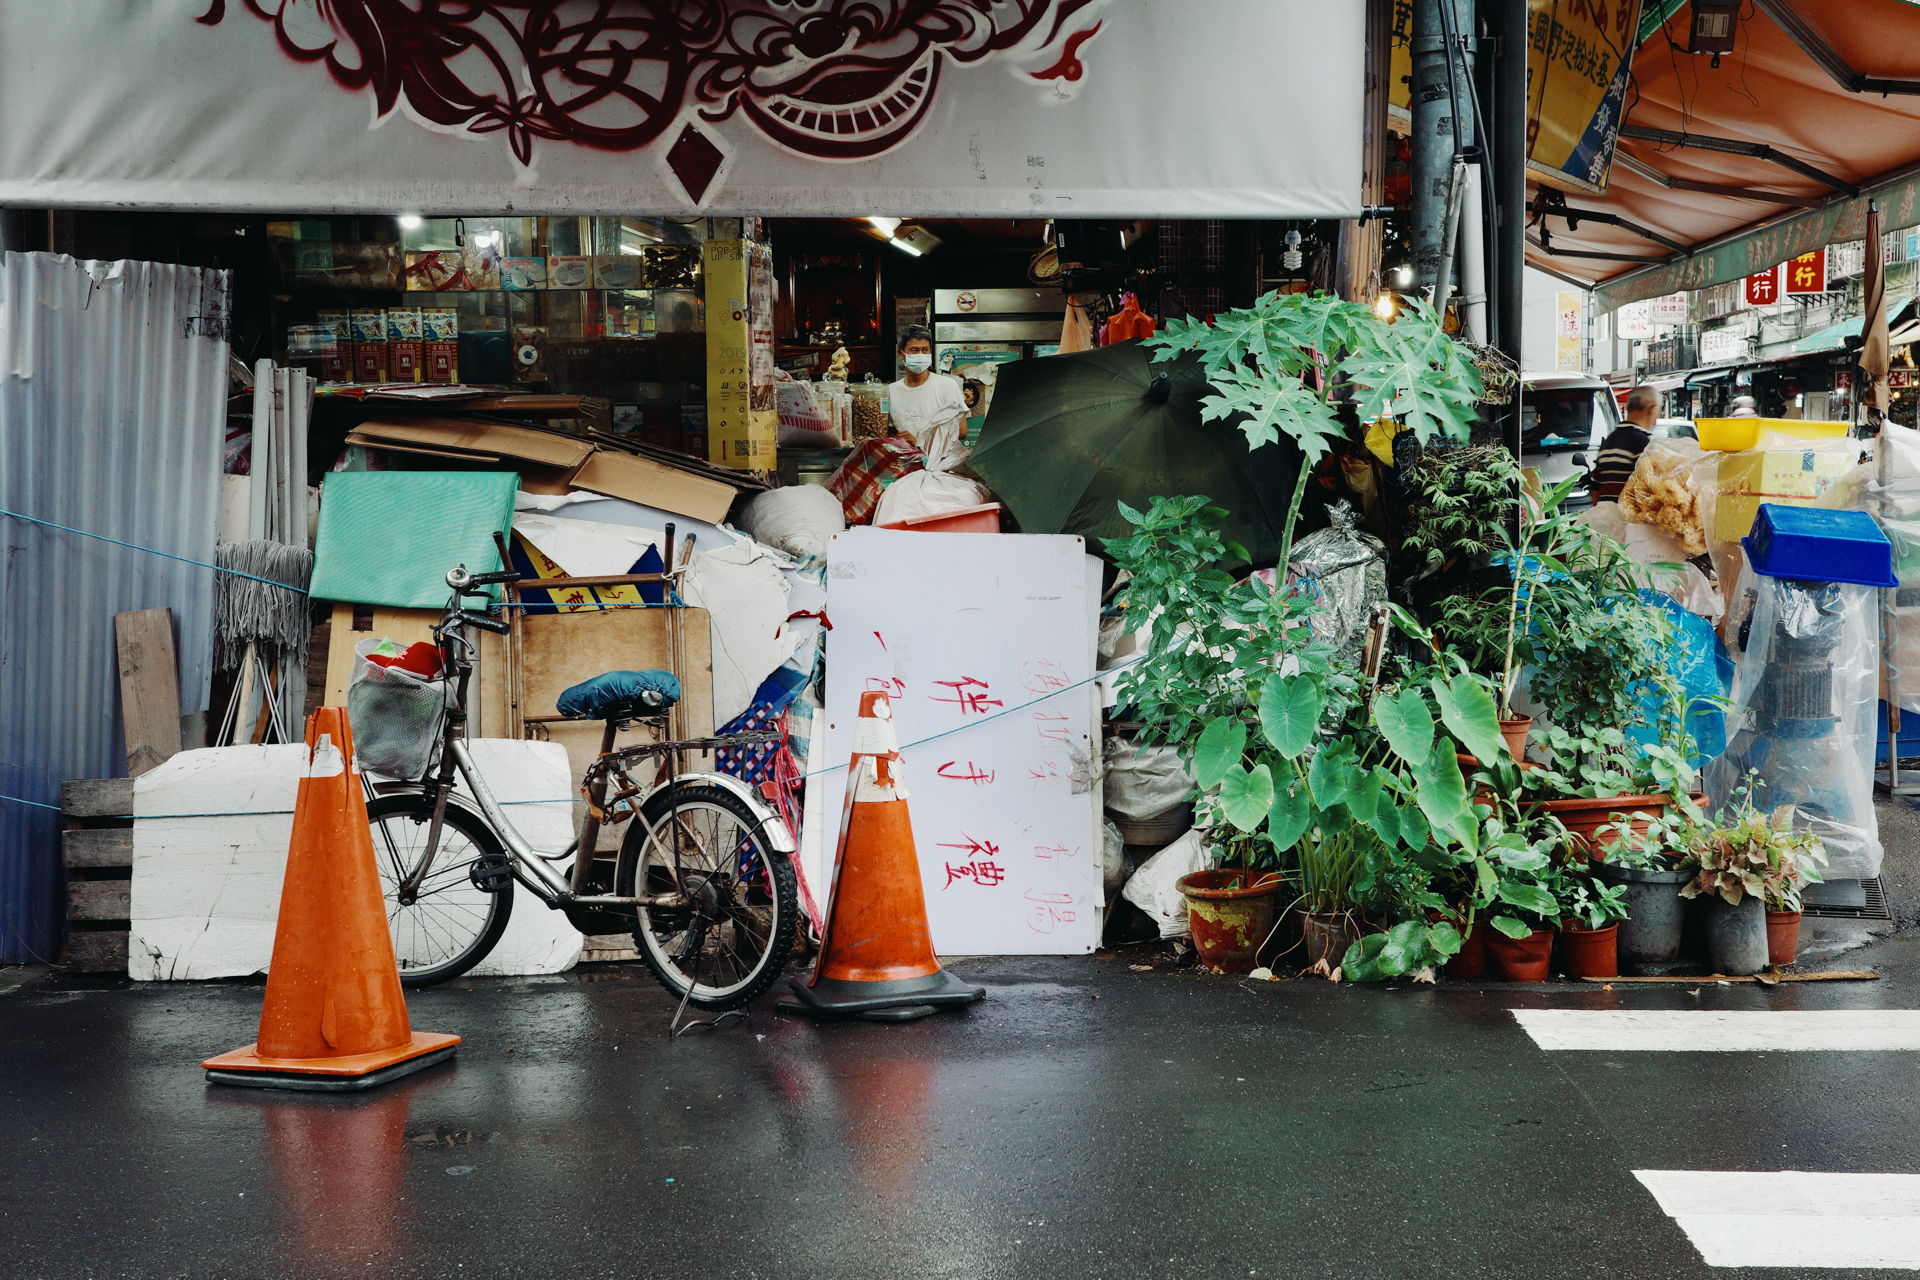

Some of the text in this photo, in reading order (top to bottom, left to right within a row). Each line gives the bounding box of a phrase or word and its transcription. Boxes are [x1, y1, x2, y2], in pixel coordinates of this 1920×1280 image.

[711, 246, 729, 254] POP
[718, 347, 747, 358] 2019
[928, 675, 1006, 891] 伴手禮
